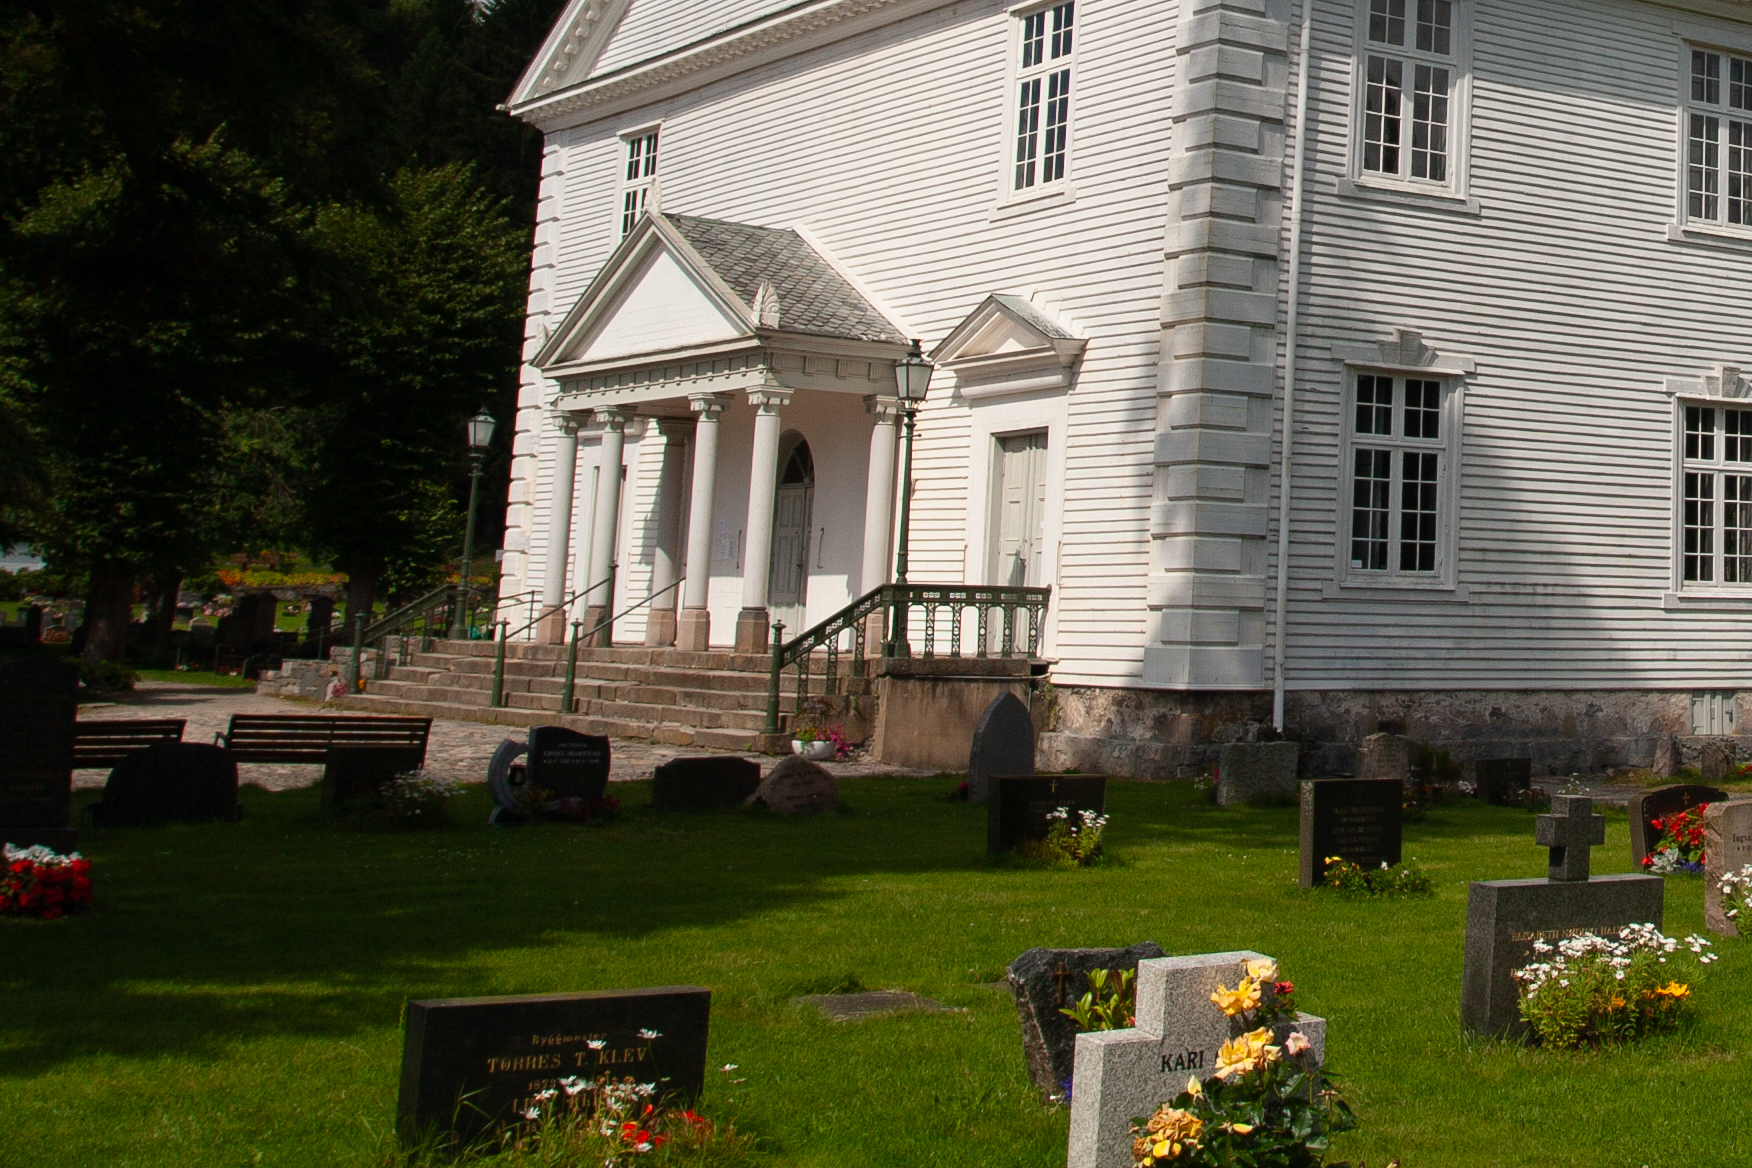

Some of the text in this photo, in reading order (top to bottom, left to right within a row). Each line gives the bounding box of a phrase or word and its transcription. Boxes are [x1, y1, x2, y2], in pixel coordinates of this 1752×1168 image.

[532, 1033, 606, 1045] Byggmester
[598, 1048, 646, 1064] KLEV
[1160, 1050, 1205, 1073] KARI
